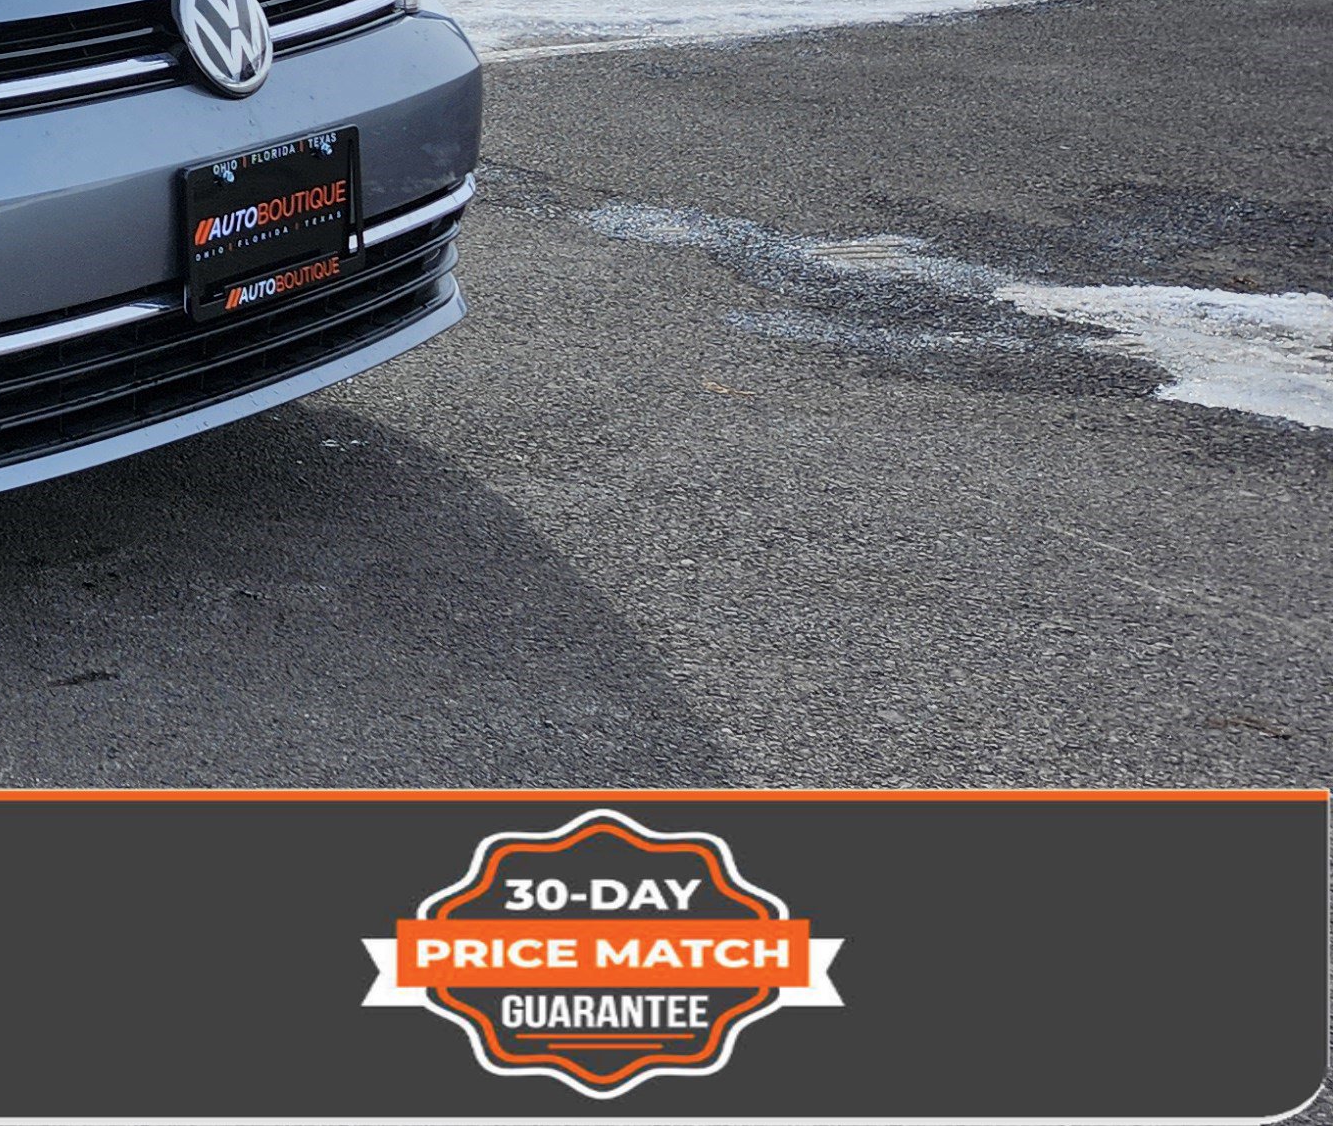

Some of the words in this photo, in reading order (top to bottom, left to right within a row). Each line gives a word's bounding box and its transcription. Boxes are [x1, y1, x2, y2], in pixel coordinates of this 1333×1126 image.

[250, 144, 296, 165] FLORIDA
[307, 132, 337, 150] TEXAS
[237, 225, 289, 248] FLORIDA
[303, 210, 343, 228] TEXAS
